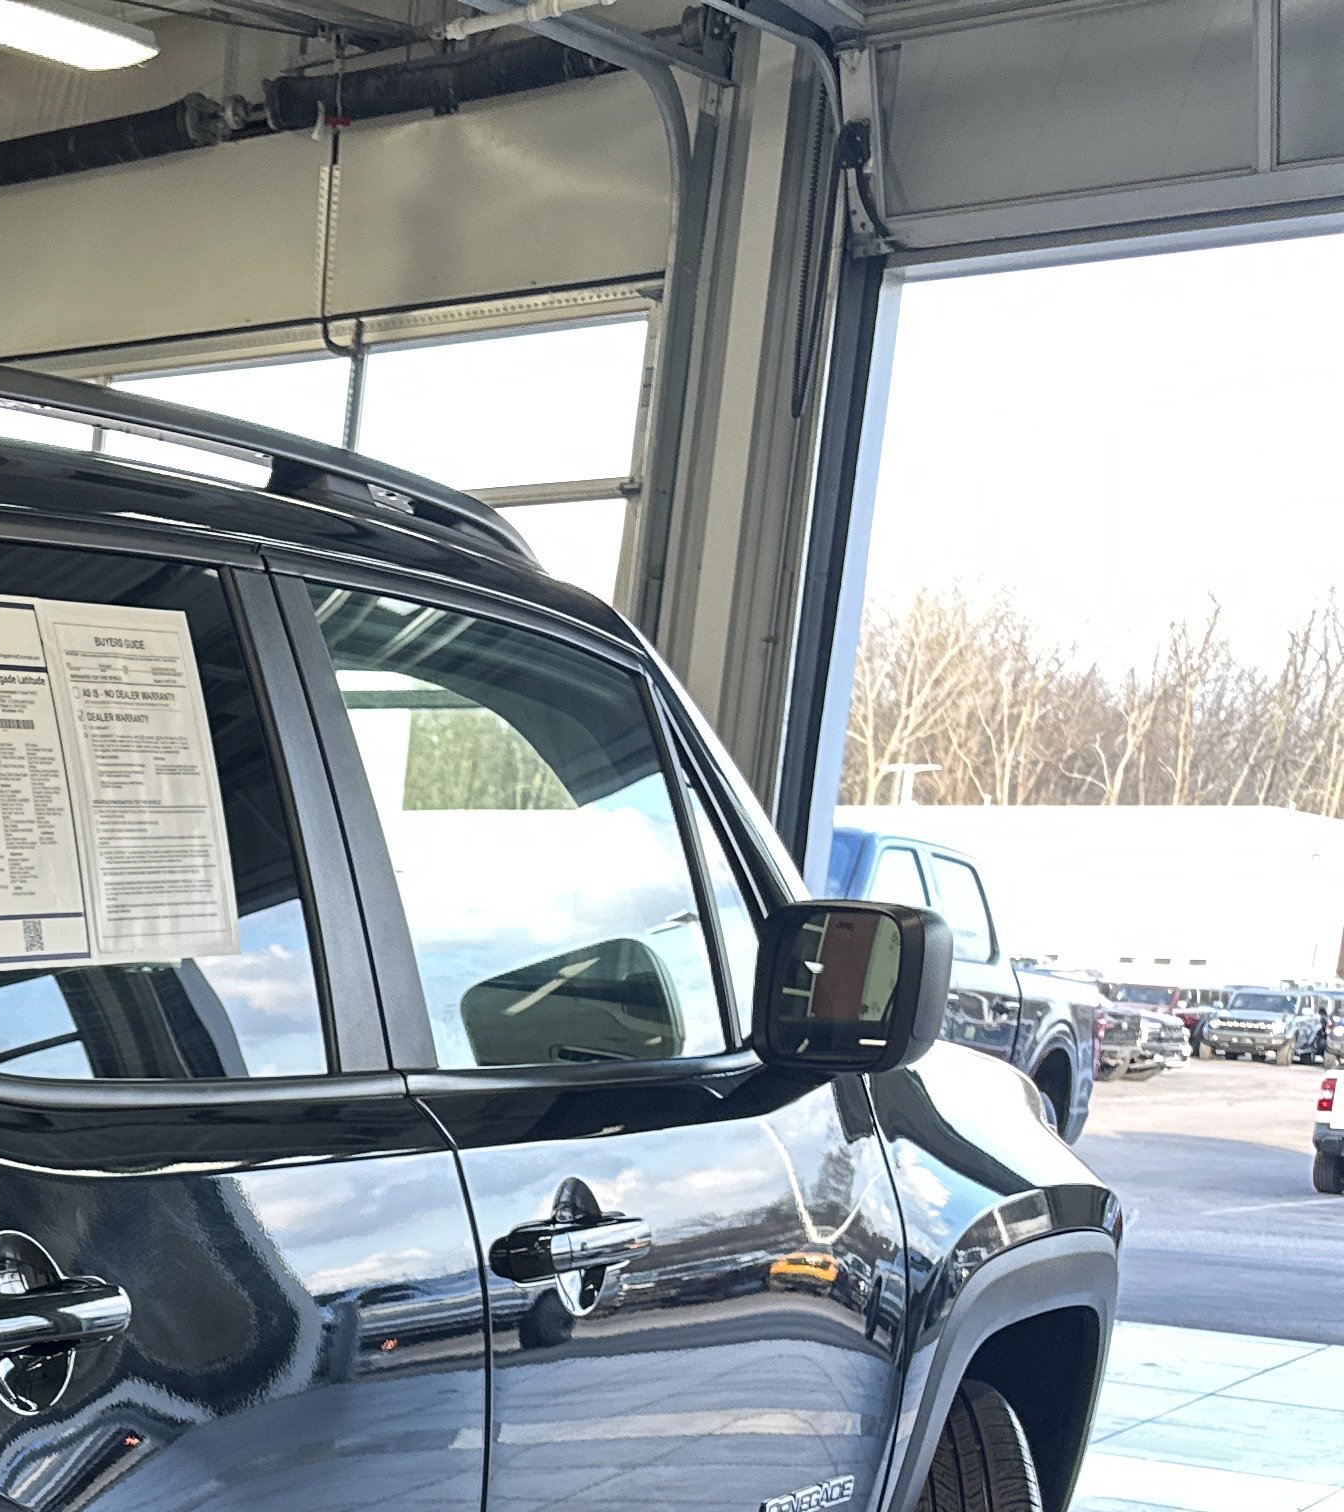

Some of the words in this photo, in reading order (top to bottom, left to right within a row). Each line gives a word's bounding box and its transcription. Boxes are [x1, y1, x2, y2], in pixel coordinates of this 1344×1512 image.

[94, 637, 123, 648] BUYERS
[124, 639, 145, 650] GUIDE
[18, 675, 45, 685] Latitude
[104, 690, 114, 698] NO
[115, 690, 140, 700] DEALER
[141, 692, 175, 701] WARRANTY
[86, 712, 113, 721] DEALER
[115, 713, 149, 723] WARRANTY
